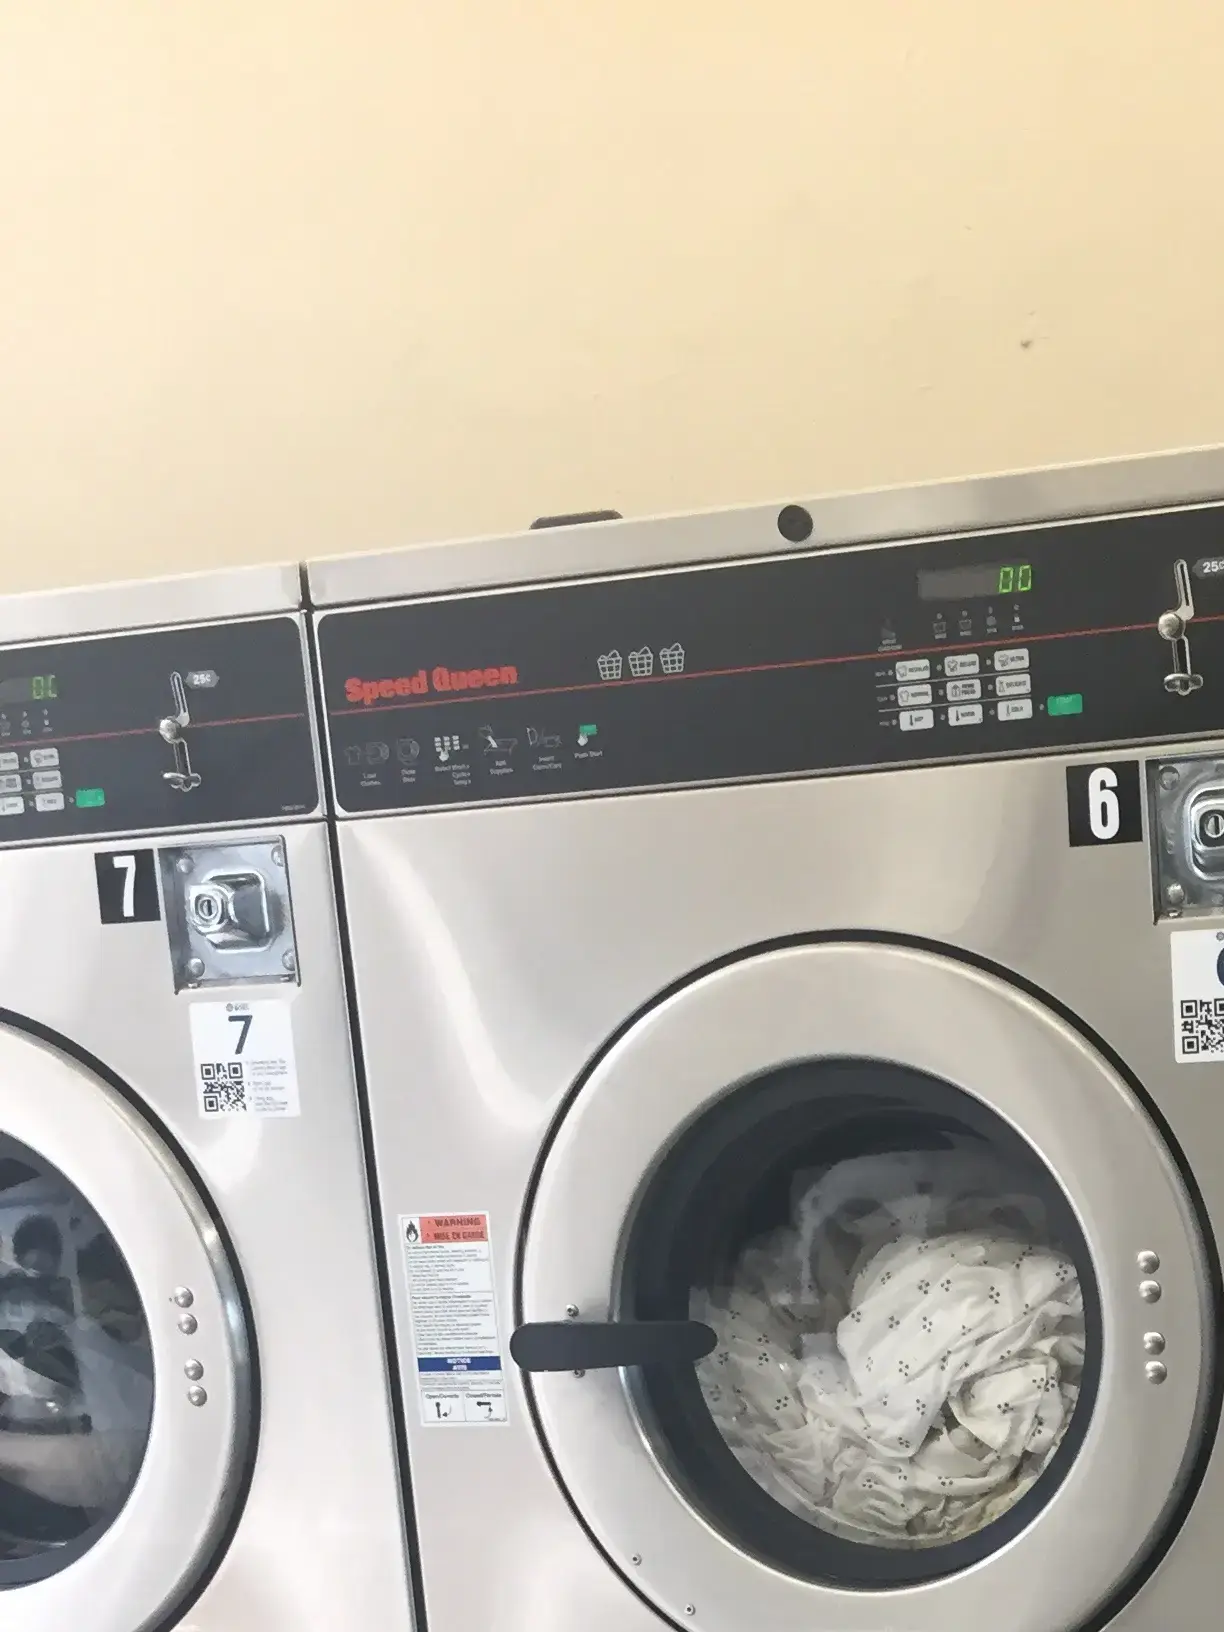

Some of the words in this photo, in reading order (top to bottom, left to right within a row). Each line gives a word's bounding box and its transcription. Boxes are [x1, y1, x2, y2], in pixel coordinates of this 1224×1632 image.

[1202, 559, 1224, 573] 25¢
[344, 669, 428, 705] Speed
[432, 665, 518, 692] Queen
[1088, 766, 1120, 839] 6
[113, 855, 138, 918] 7
[228, 1015, 253, 1055] 7
[434, 1218, 481, 1228] WARNING
